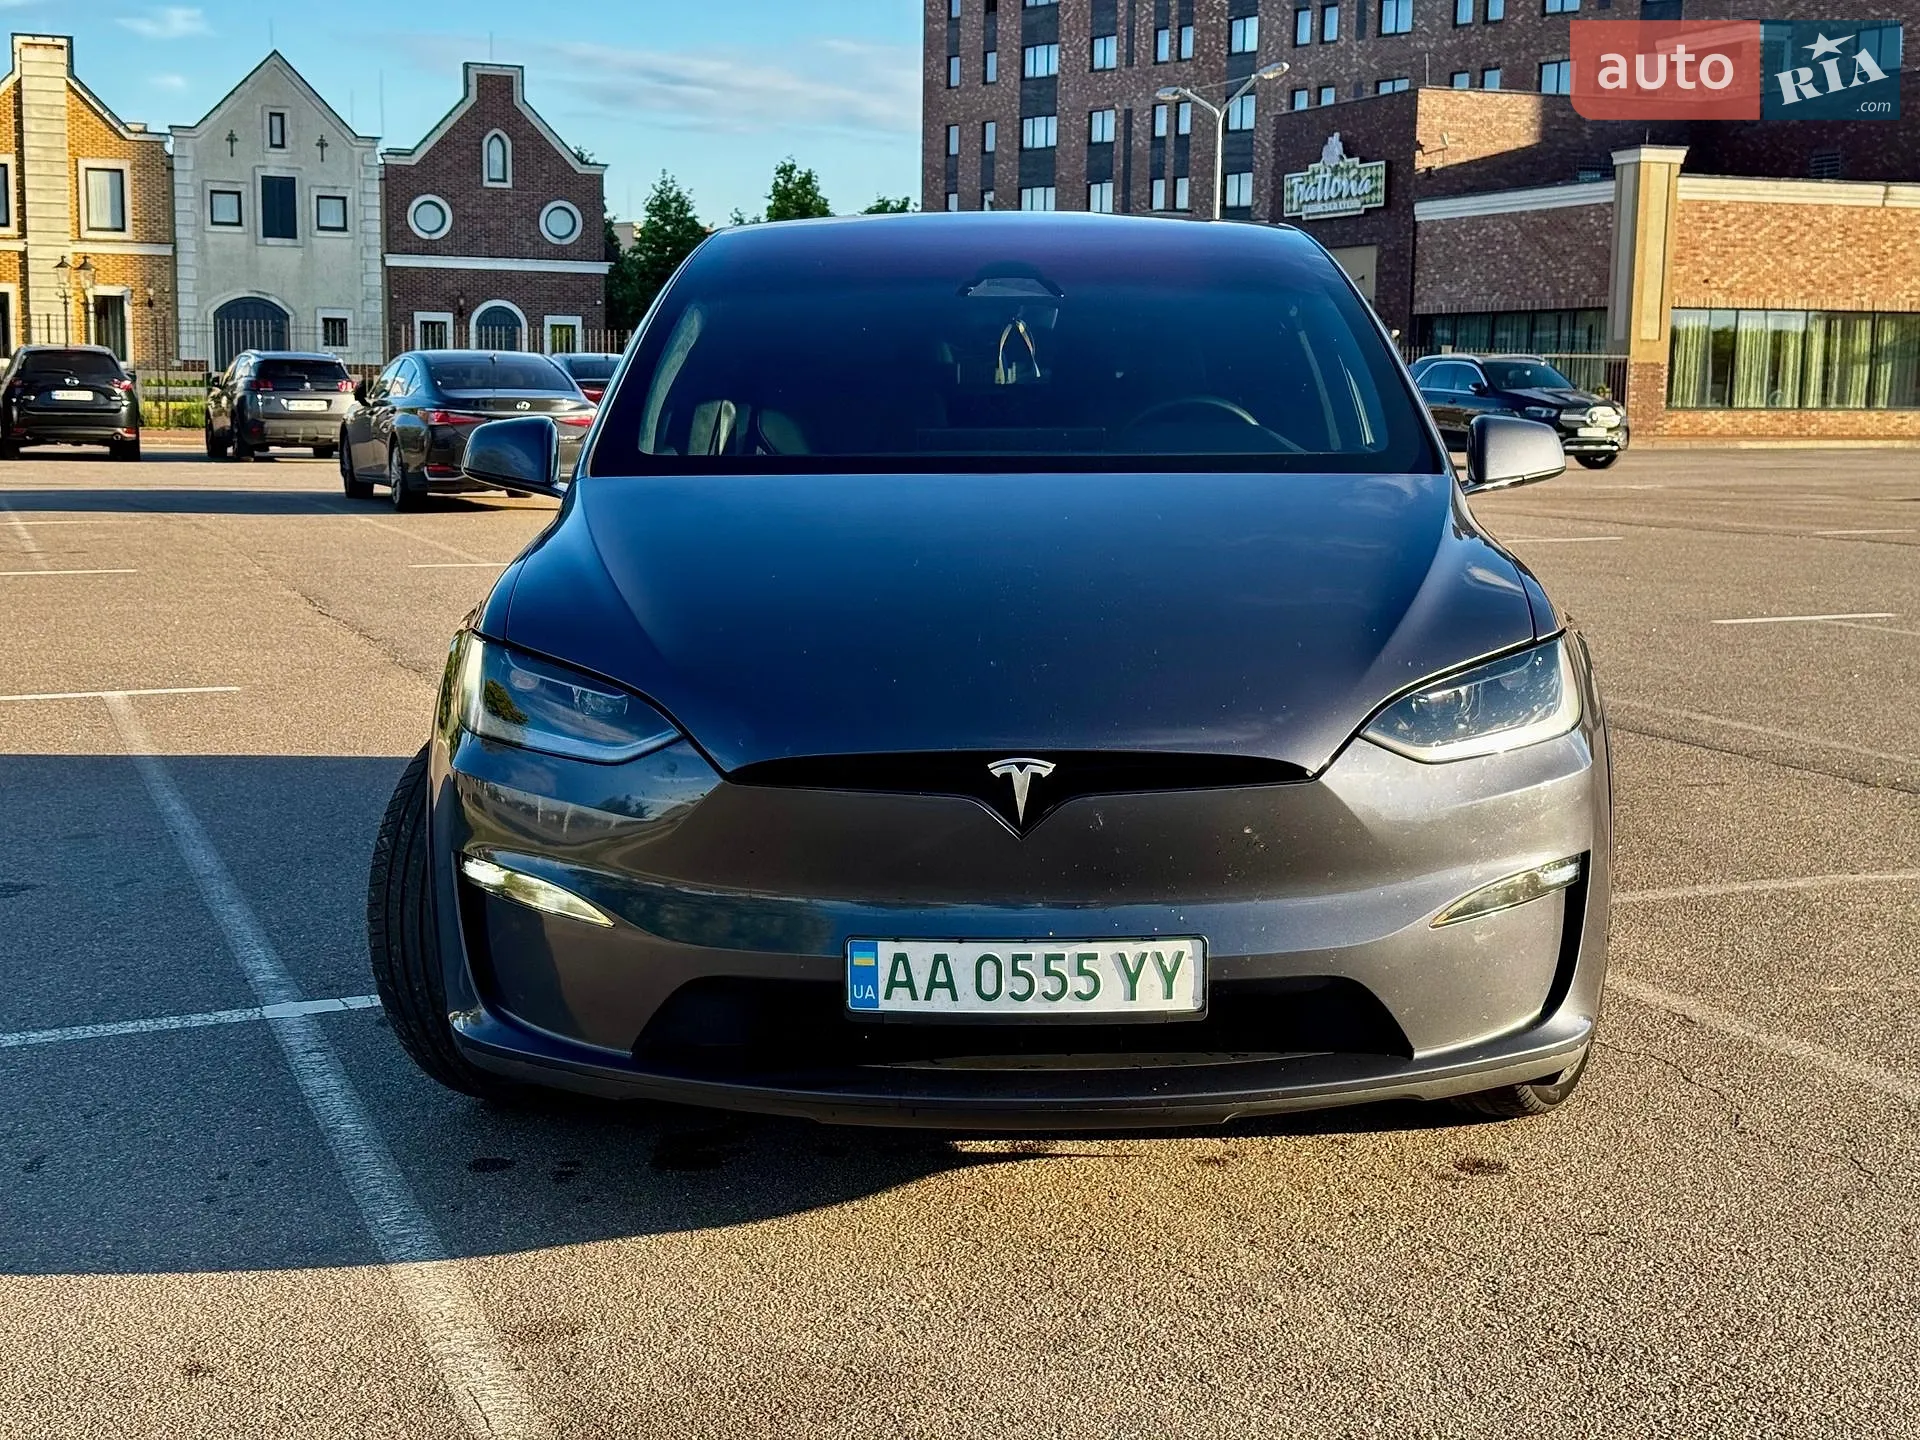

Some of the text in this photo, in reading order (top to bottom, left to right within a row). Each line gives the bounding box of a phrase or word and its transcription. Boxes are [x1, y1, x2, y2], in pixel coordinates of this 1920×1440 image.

[1292, 166, 1371, 211] Trattoria
[853, 985, 876, 1000] UA
[884, 950, 1186, 1003] AA 0555 YY
